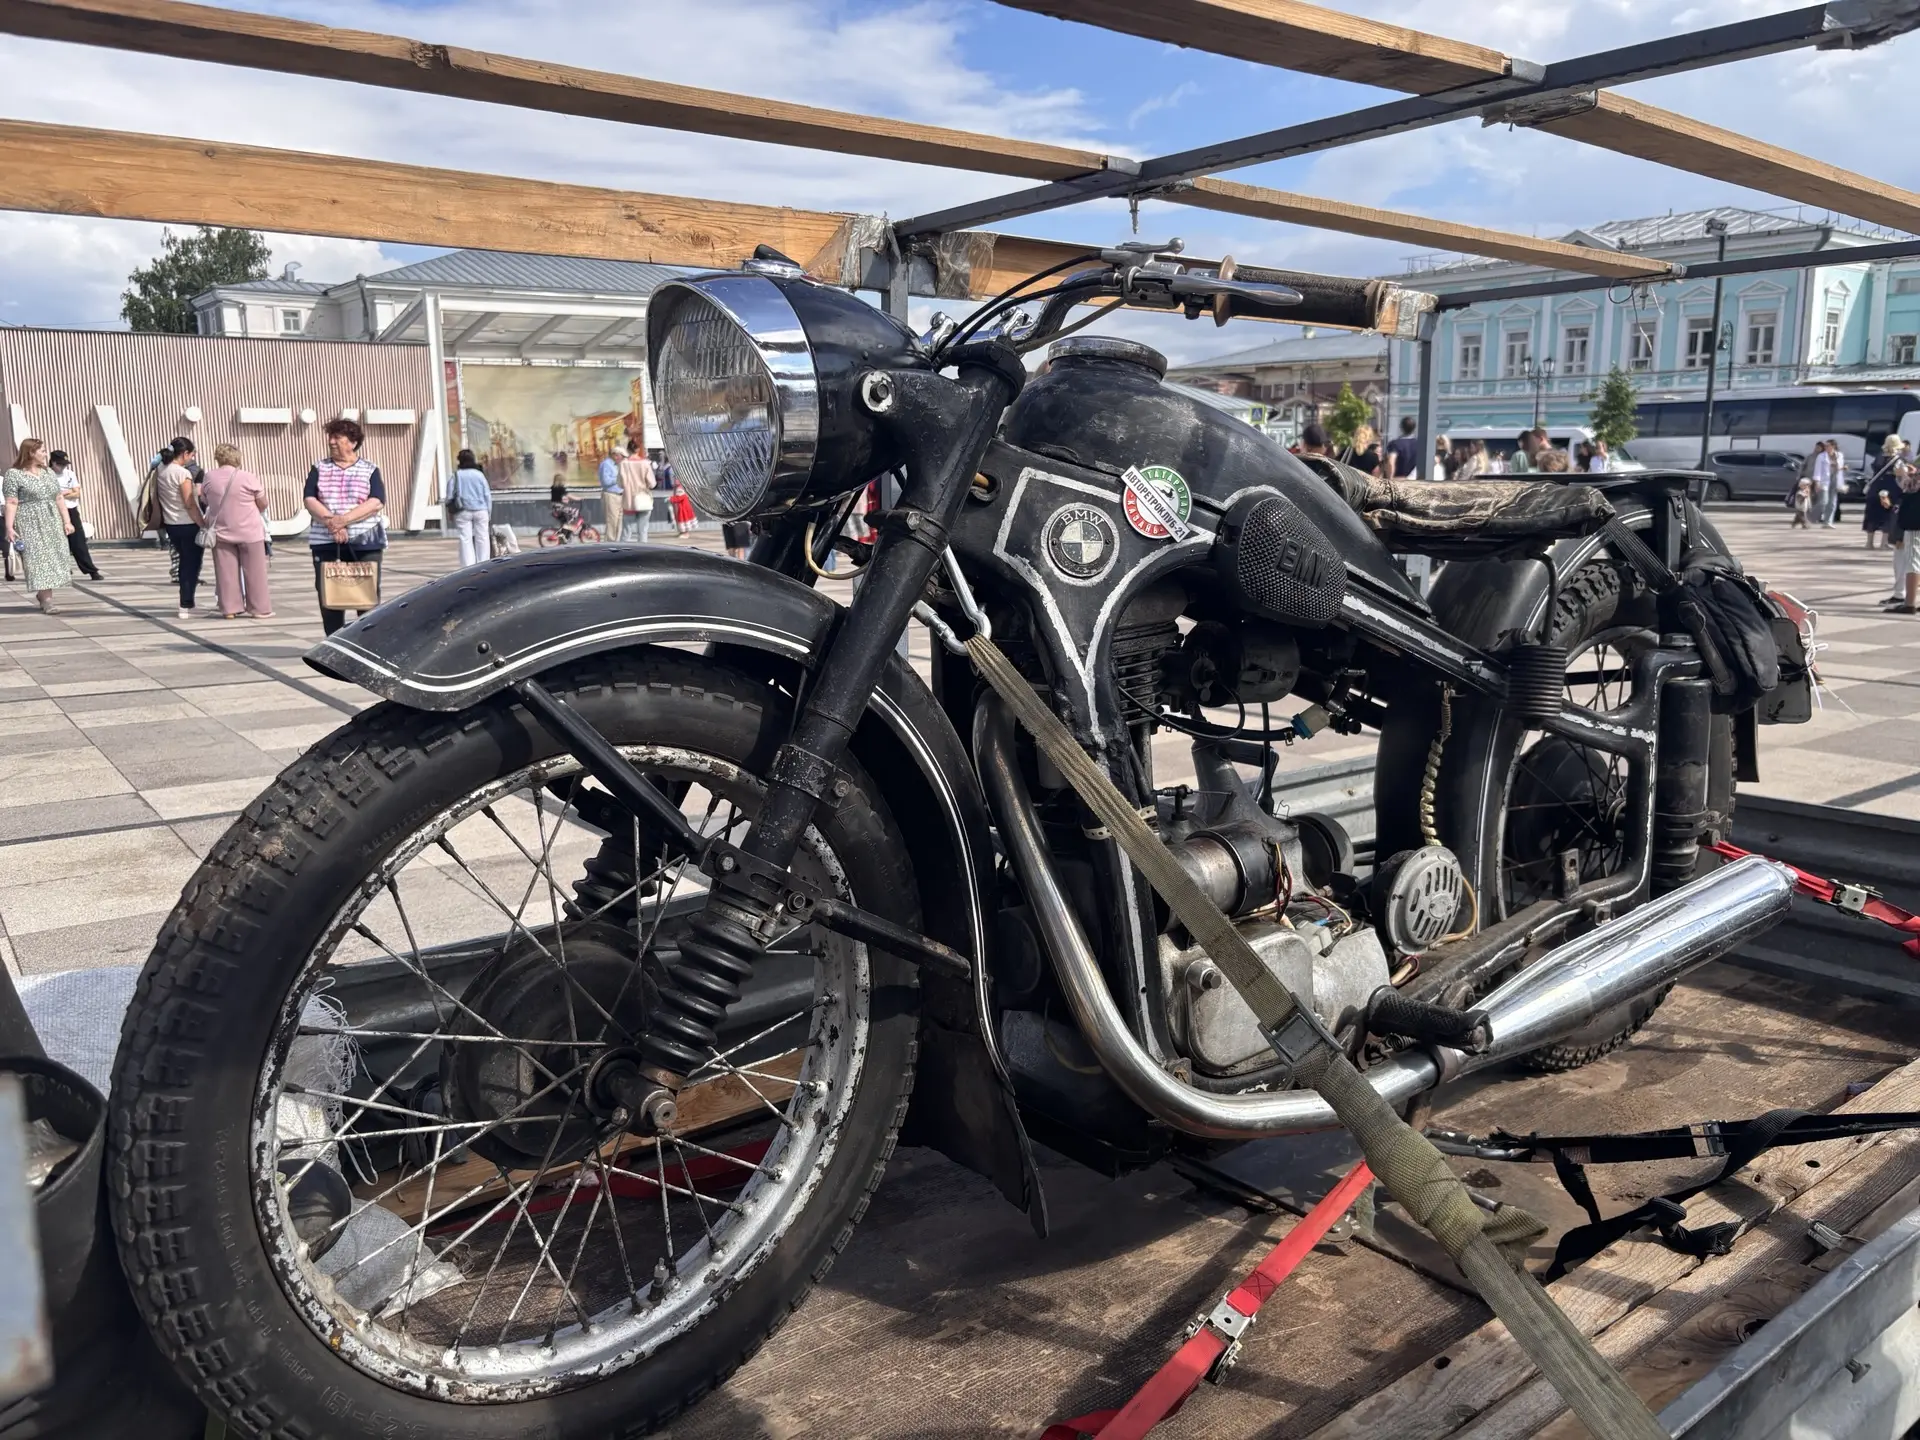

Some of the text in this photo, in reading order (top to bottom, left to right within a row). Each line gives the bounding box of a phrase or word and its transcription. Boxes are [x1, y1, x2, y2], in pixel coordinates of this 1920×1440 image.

[1125, 470, 1186, 539] АВТОРЕТРОКЛУБ-21
[1147, 470, 1187, 517] ТАТАРСТАН
[1061, 510, 1105, 526] BMW
[1127, 500, 1158, 535] КАЗАНЬ
[1276, 537, 1331, 589] BMW
